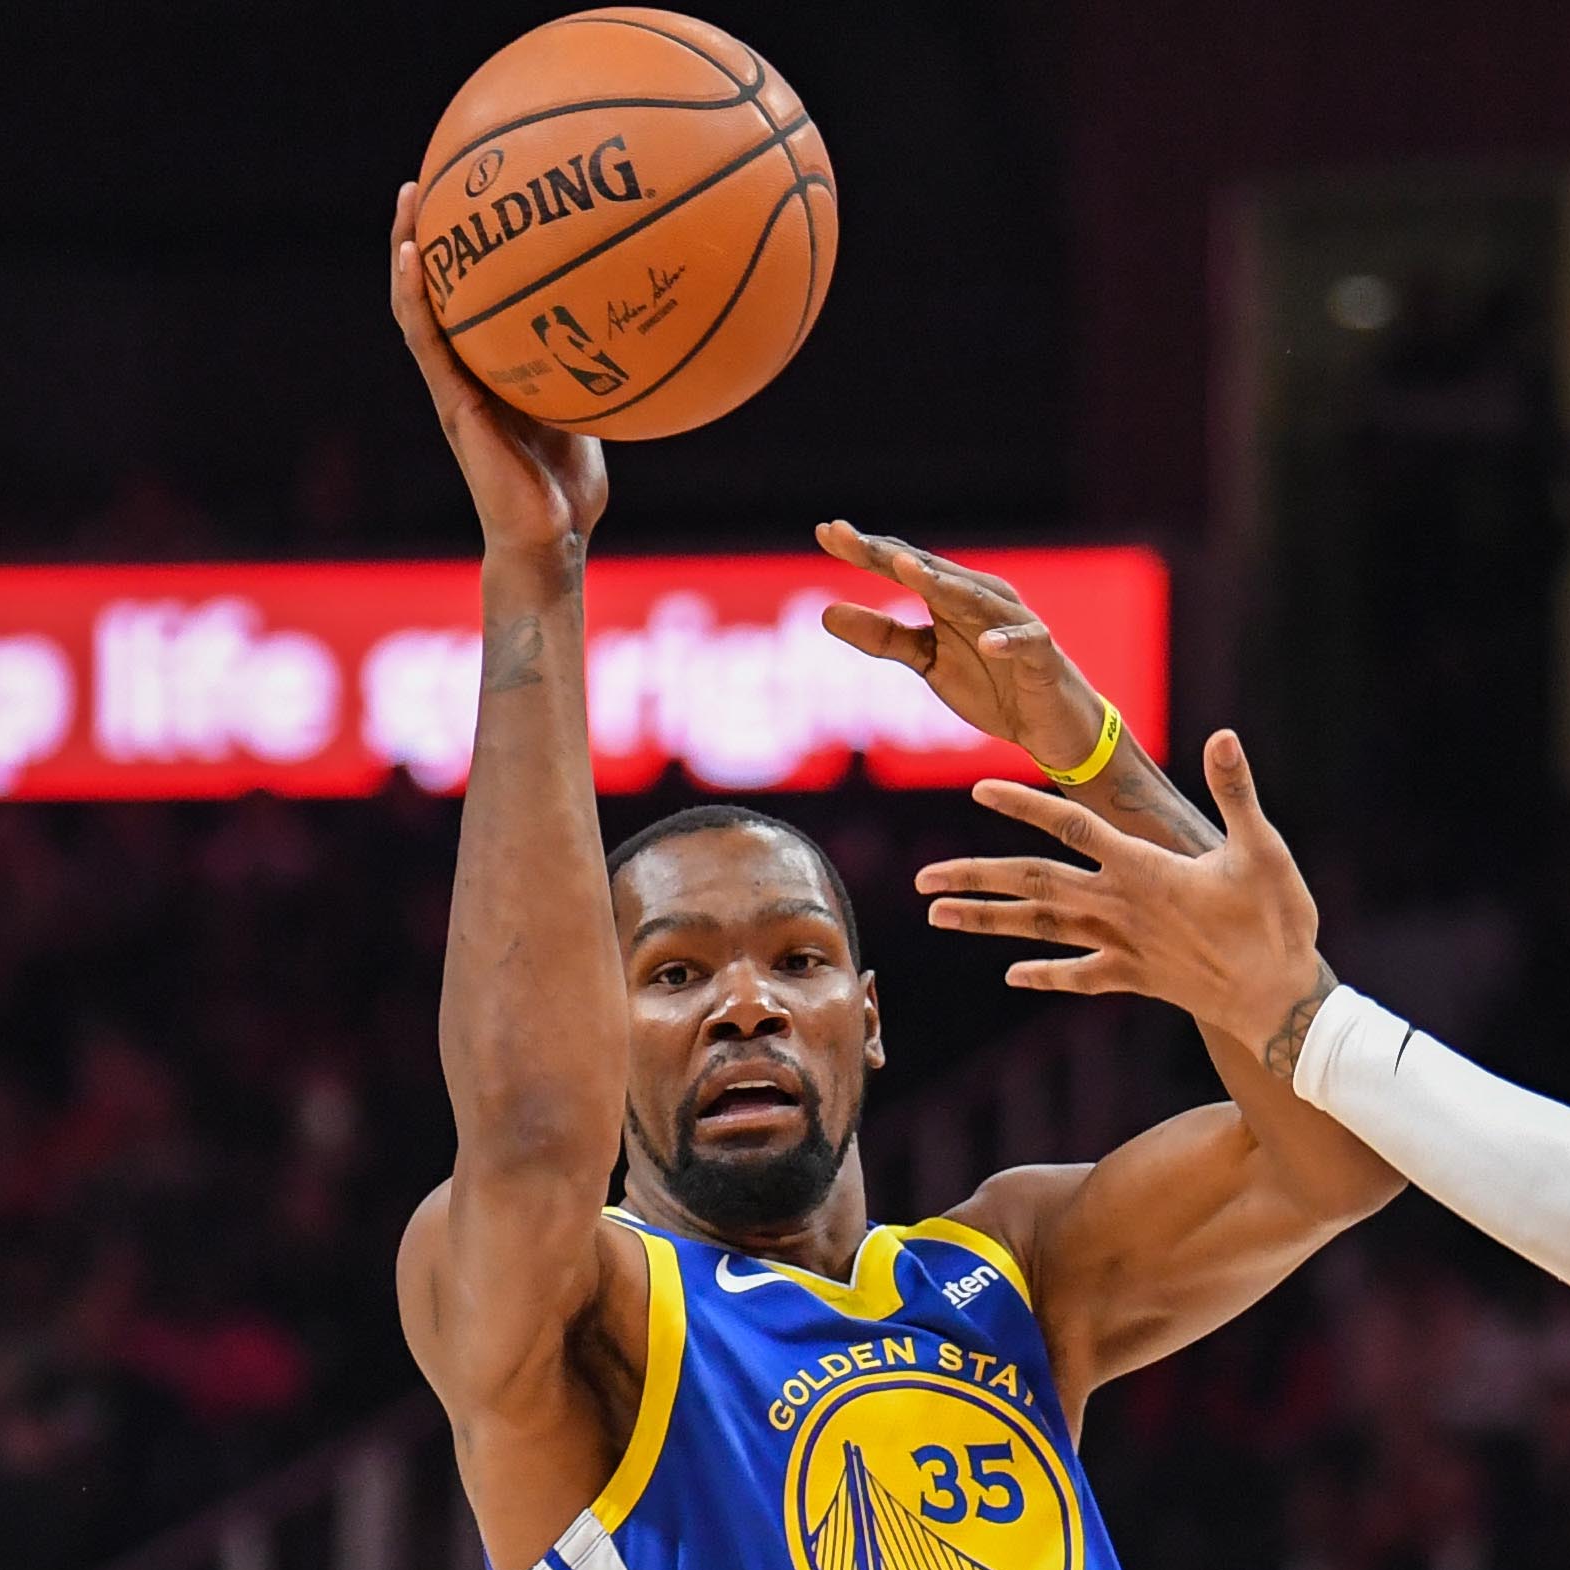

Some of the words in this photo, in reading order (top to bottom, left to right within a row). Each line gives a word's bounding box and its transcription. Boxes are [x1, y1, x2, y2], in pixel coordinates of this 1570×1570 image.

[91, 595, 343, 764] life
[769, 1336, 917, 1432] GOLDEN
[910, 1439, 1026, 1525] 35
